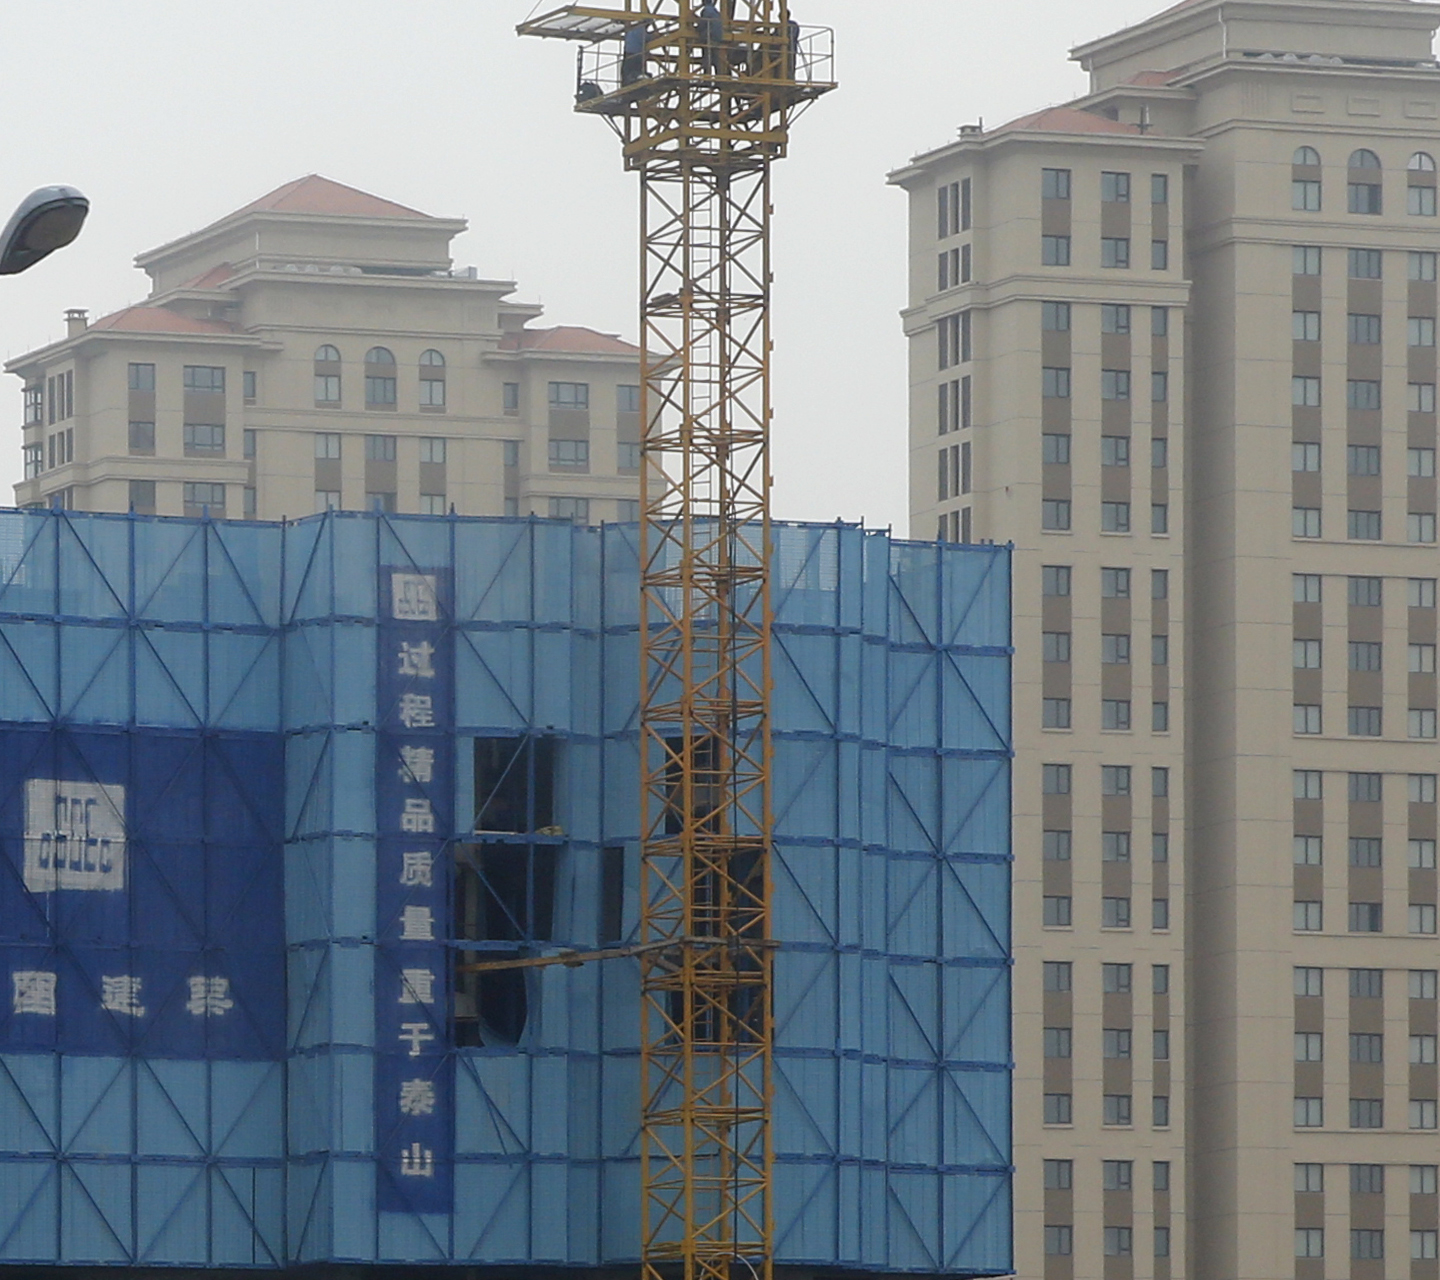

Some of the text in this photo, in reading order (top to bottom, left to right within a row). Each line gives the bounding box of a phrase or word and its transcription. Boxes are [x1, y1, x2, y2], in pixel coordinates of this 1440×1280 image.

[397, 640, 437, 1177] 过程精品质量重于泰山
